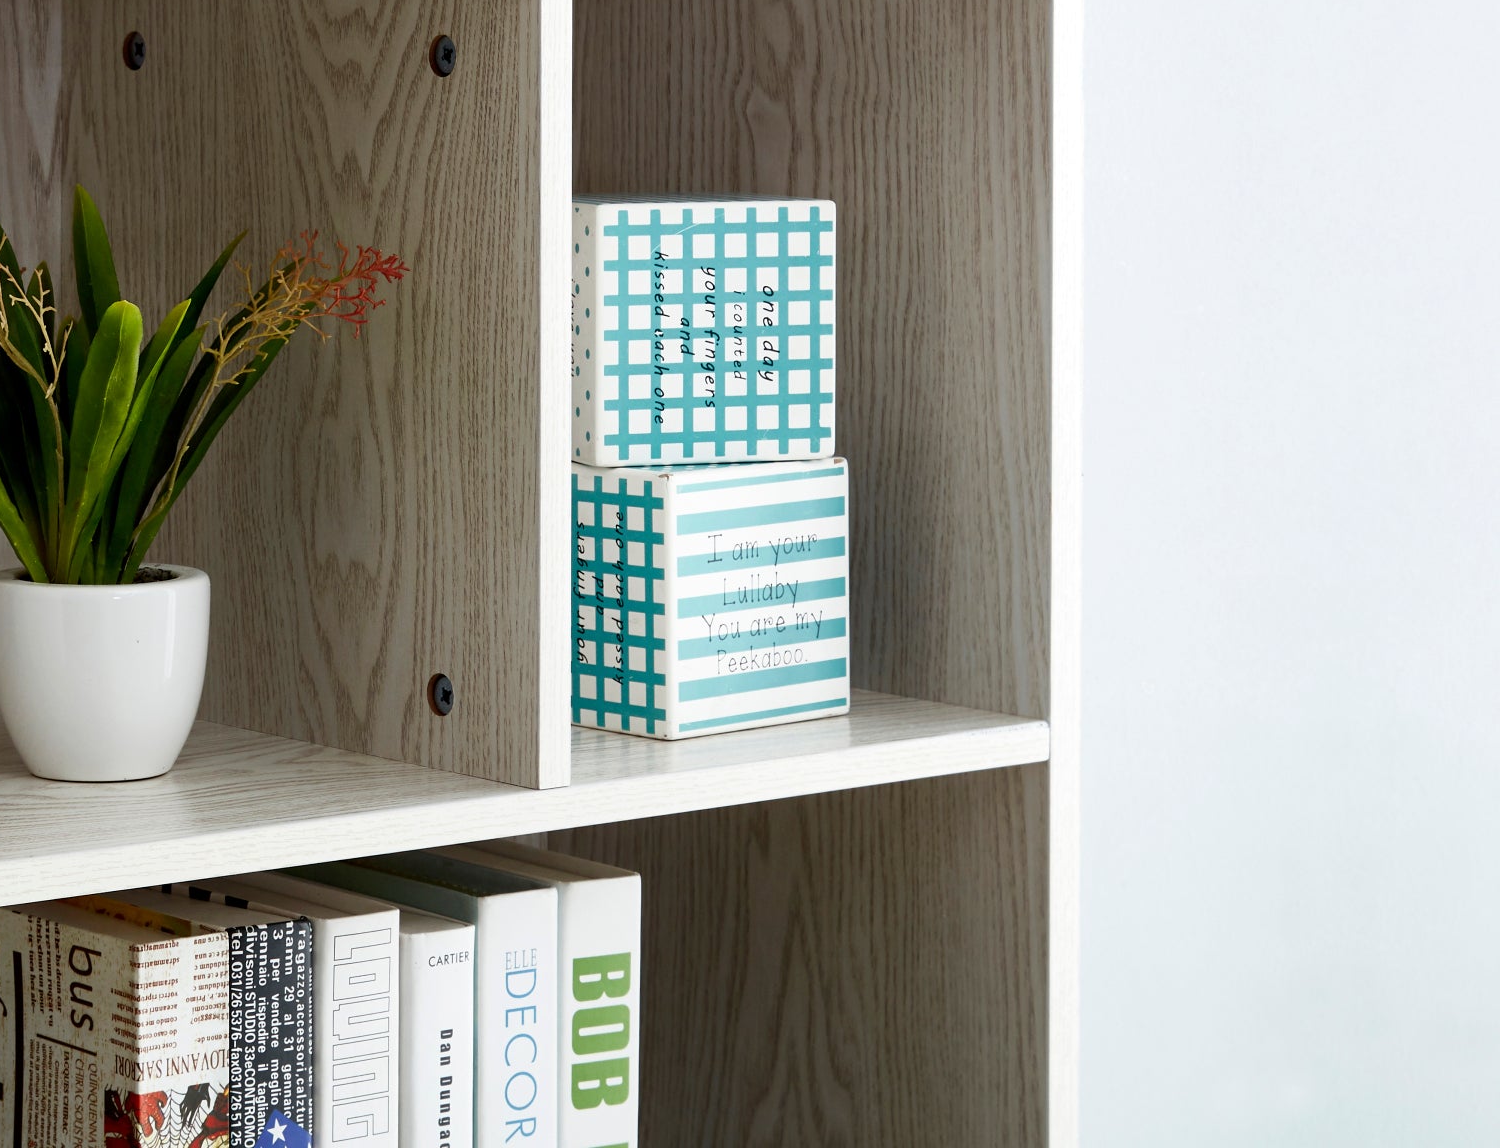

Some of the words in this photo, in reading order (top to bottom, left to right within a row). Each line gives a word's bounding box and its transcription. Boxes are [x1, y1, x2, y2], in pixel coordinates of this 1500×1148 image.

[654, 251, 670, 318] kissed
[701, 266, 715, 318] your
[762, 286, 774, 327] one
[680, 317, 695, 356] and
[734, 304, 746, 380] counted
[700, 329, 720, 409] fingers
[759, 340, 780, 382] day
[654, 387, 664, 424] one
[616, 511, 624, 549] one
[707, 534, 722, 563] I
[732, 539, 759, 561] am
[768, 533, 817, 566] your
[574, 521, 588, 600] fingers
[593, 576, 604, 615] and
[613, 558, 624, 609] each
[723, 572, 799, 608] Lullaby
[576, 610, 588, 664] your
[702, 613, 741, 642] You
[750, 615, 786, 637] are
[795, 610, 823, 639] my
[613, 617, 624, 685] kissed
[717, 642, 808, 674] Peekaboo.
[273, 929, 283, 940] 3
[245, 926, 257, 989] divisoni
[269, 958, 280, 982] per
[428, 951, 470, 968] CARTIER
[505, 948, 538, 971] ELLE
[68, 944, 101, 1031] bus
[284, 986, 294, 1002] 29
[244, 992, 255, 1043] STUDIO
[256, 997, 269, 1053] rispedire
[271, 994, 281, 1048] vendere
[283, 1014, 294, 1026] al
[332, 928, 391, 1142] LOVING
[571, 952, 631, 1110] BOB
[283, 1037, 294, 1052] 31
[440, 1029, 453, 1066] Dan
[504, 968, 538, 1144] DECOR
[268, 1059, 281, 1105] meglio
